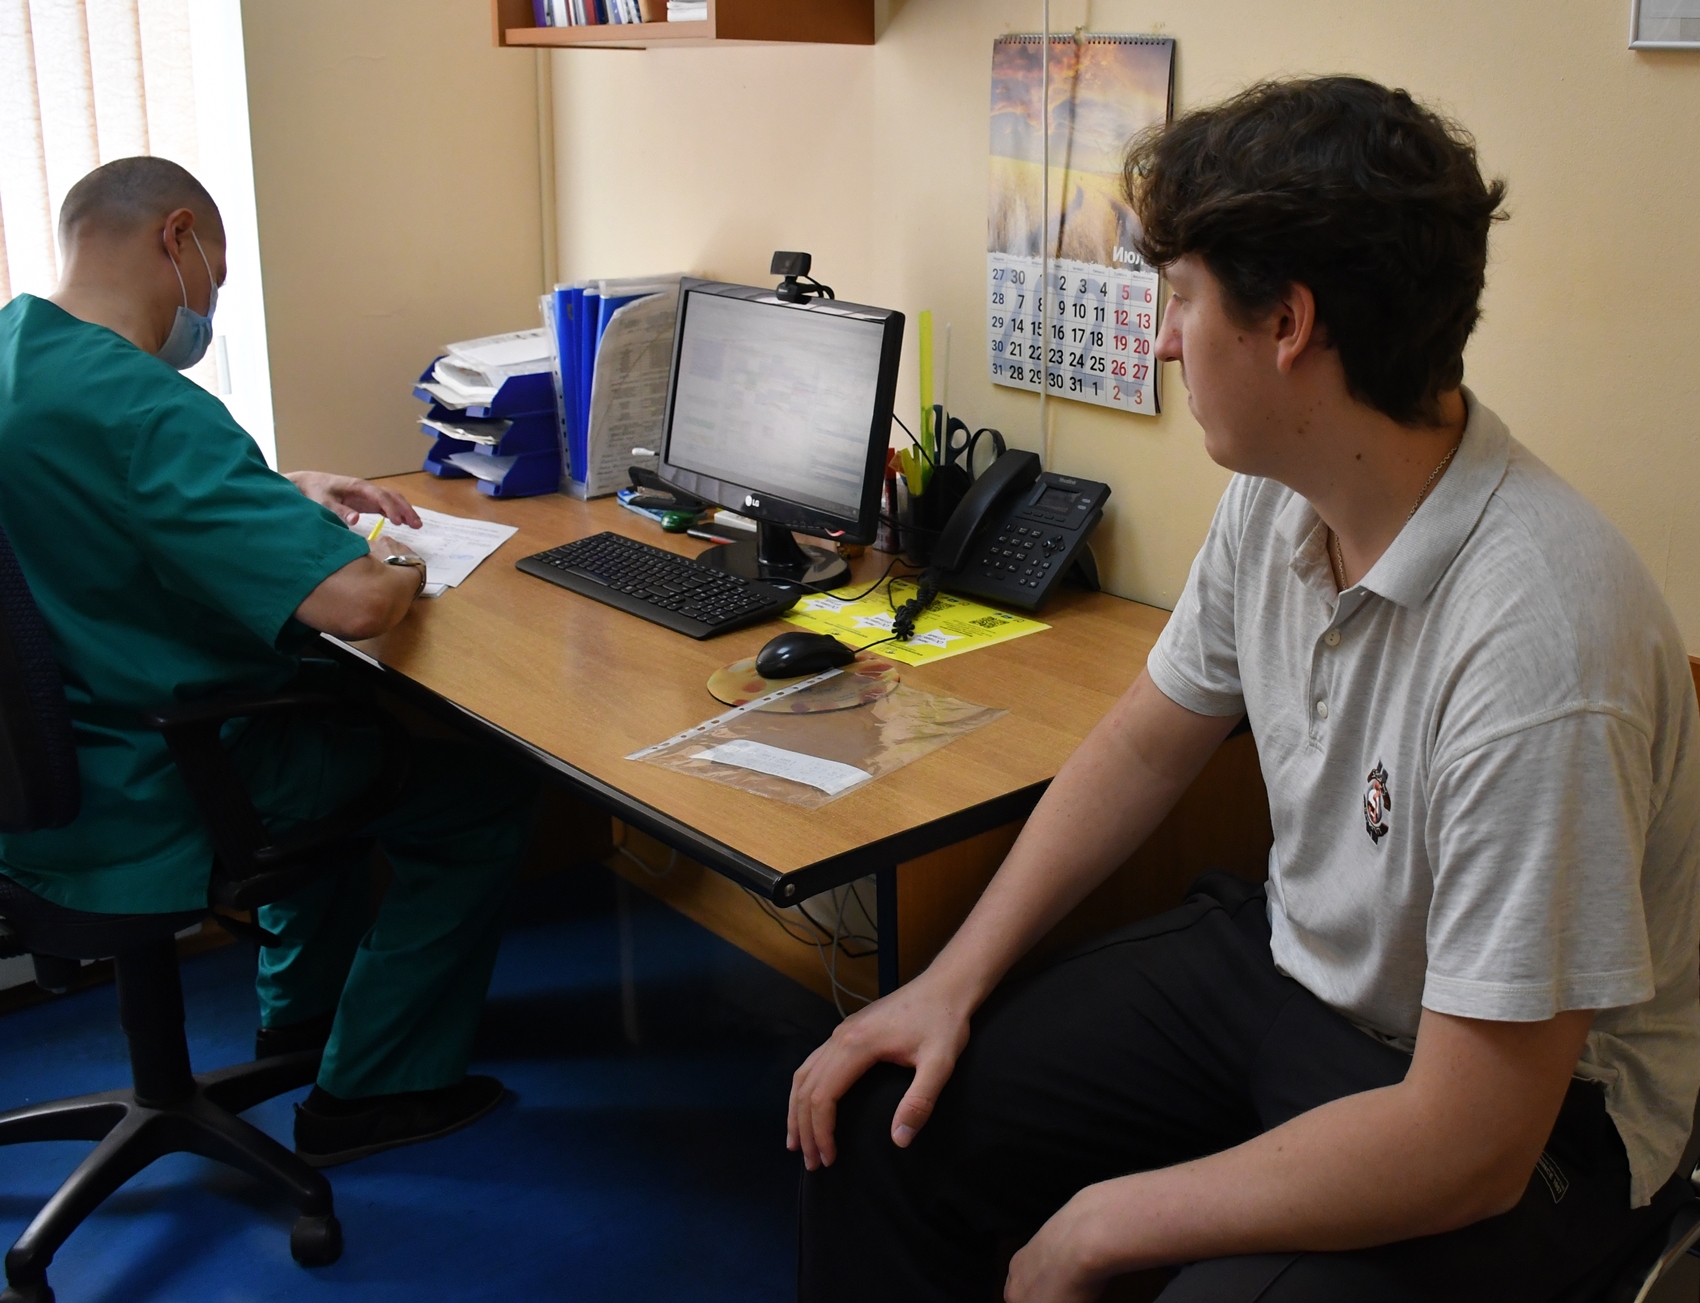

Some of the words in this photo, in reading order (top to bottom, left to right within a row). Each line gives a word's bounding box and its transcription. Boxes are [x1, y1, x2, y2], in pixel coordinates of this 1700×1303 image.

[1113, 245, 1146, 266] Июл
[993, 269, 1004, 280] 27
[1011, 270, 1025, 285] 30
[1060, 276, 1066, 291] 2
[1080, 279, 1086, 293] 3
[1100, 282, 1107, 297] 4
[1122, 285, 1129, 300] 5
[1145, 288, 1152, 303] 6
[992, 292, 1004, 304] 28
[1018, 295, 1025, 309] 7
[1059, 301, 1065, 315] 9
[1072, 303, 1086, 318] 10
[1094, 307, 1105, 322] 11
[1114, 310, 1128, 326] 12
[1137, 313, 1150, 329] 13
[992, 316, 1003, 328] 29
[1011, 318, 1024, 333] 14
[1052, 325, 1064, 340] 16
[1072, 328, 1085, 343] 17
[1090, 332, 1103, 347] 18
[1114, 335, 1127, 350] 19
[1134, 339, 1149, 355] 20
[992, 340, 1003, 352] 30
[1010, 342, 1022, 357] 21
[1049, 349, 1063, 364] 23
[1069, 352, 1084, 368] 24
[1090, 356, 1105, 372] 25
[1111, 360, 1126, 376] 26
[1133, 364, 1148, 380] 27
[992, 363, 1002, 375] 31
[1010, 366, 1023, 381] 28
[1049, 373, 1063, 388] 30
[1070, 377, 1082, 393] 31
[1093, 382, 1098, 395] 1
[1113, 385, 1120, 400] 2
[1135, 389, 1142, 404] 3
